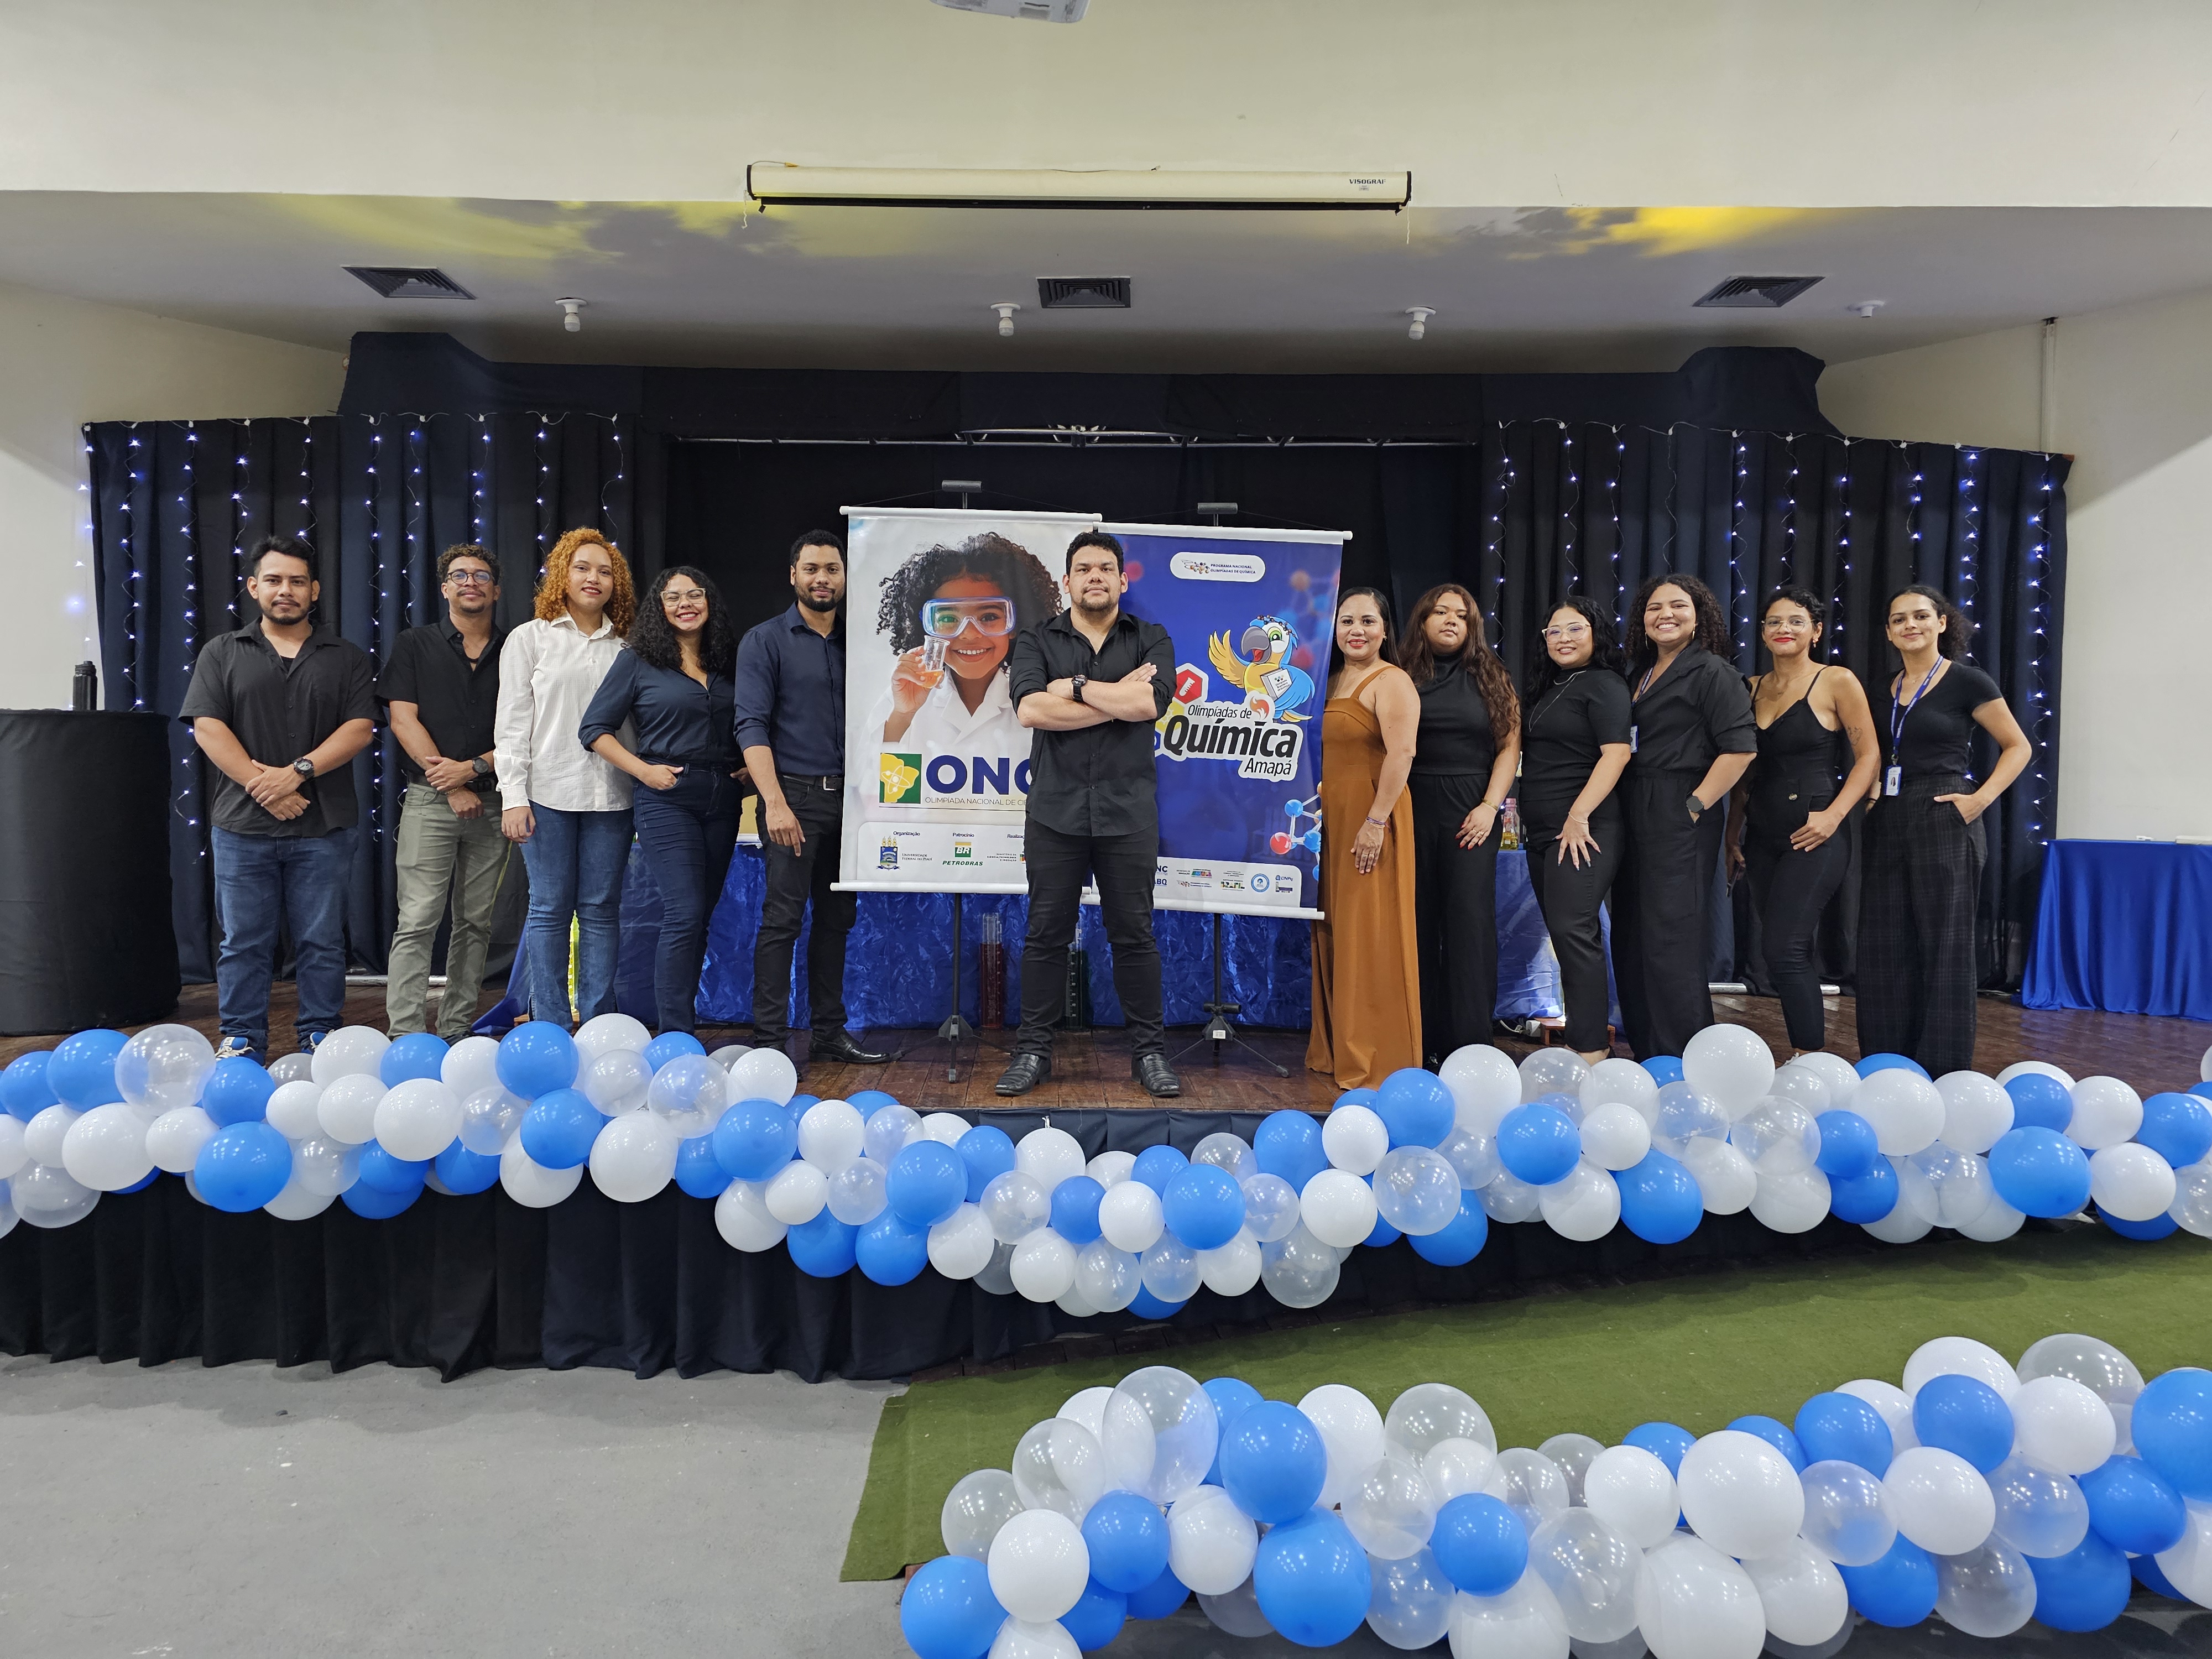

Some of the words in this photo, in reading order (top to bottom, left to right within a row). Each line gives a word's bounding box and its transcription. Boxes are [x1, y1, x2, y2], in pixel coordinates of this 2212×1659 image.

[1188, 705, 1237, 718] Olimpíadas
[1240, 707, 1252, 719] de
[1163, 715, 1297, 758] Química
[1244, 758, 1292, 777] Amapá
